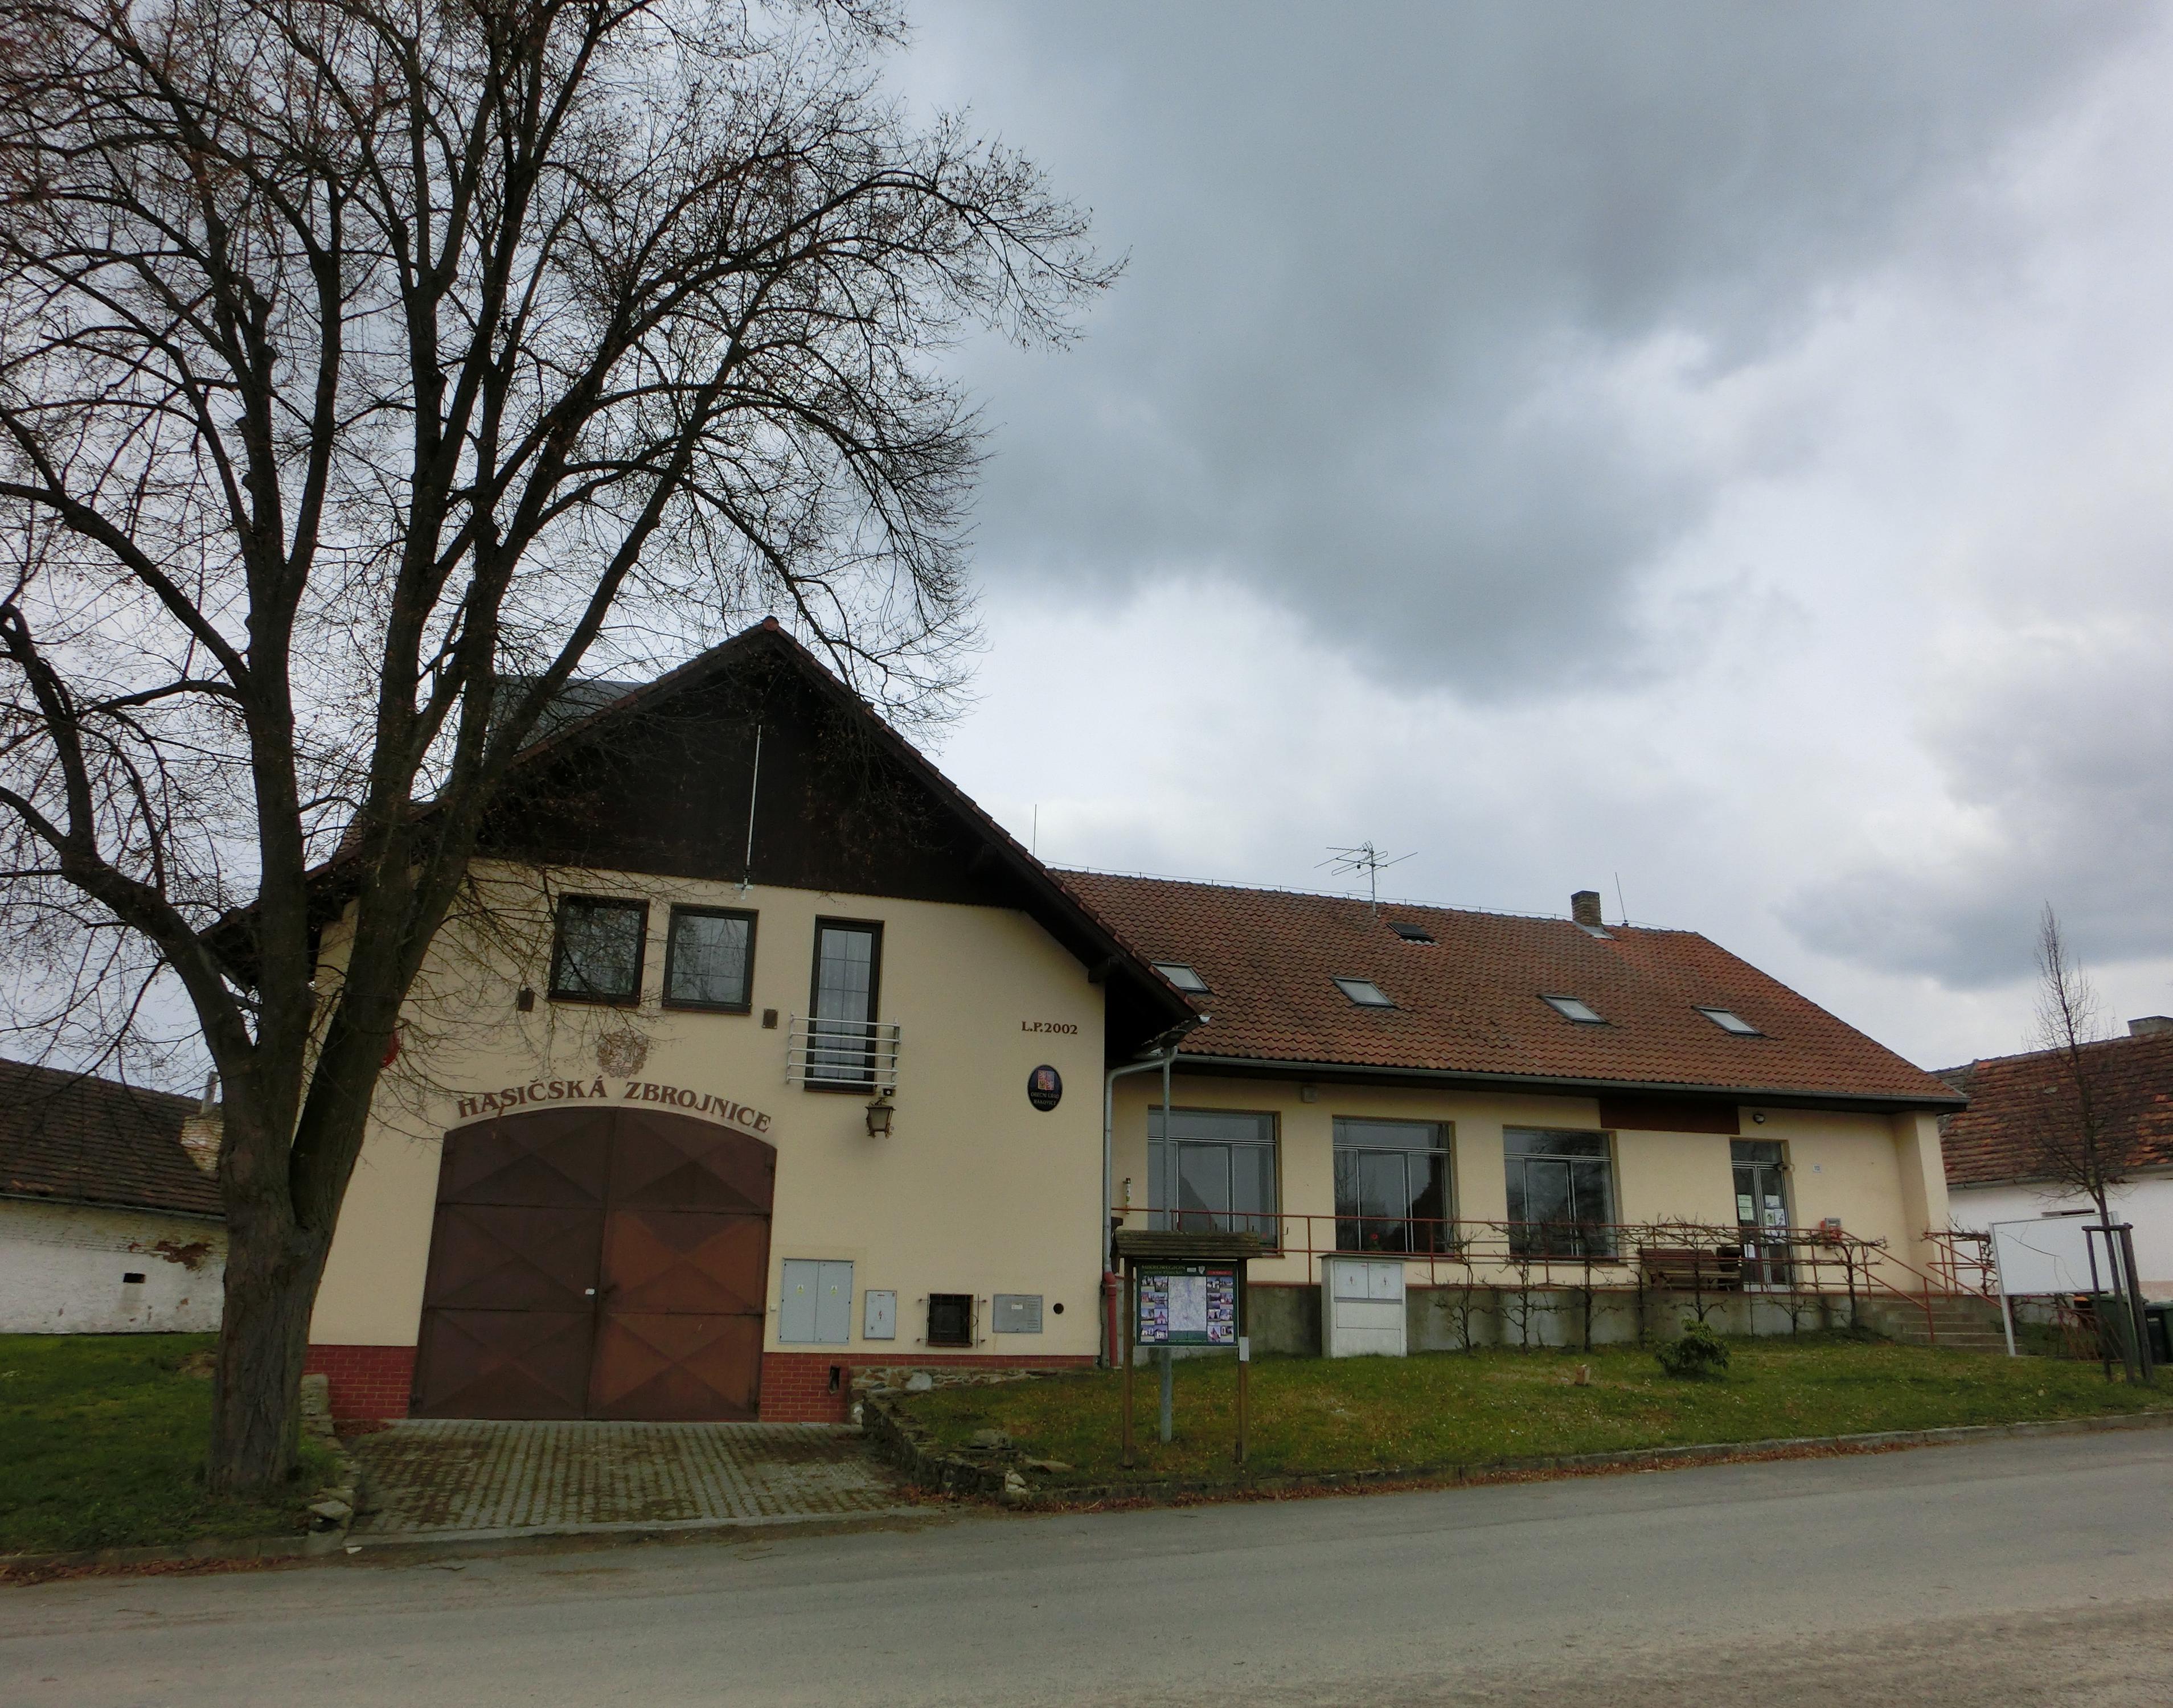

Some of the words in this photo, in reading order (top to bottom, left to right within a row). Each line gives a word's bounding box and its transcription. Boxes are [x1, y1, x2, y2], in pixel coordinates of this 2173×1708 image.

[1022, 1021, 1079, 1035] L.P.2002
[457, 1075, 608, 1119] HASIČSKÁ
[624, 1081, 772, 1134] ZBROJNICE
